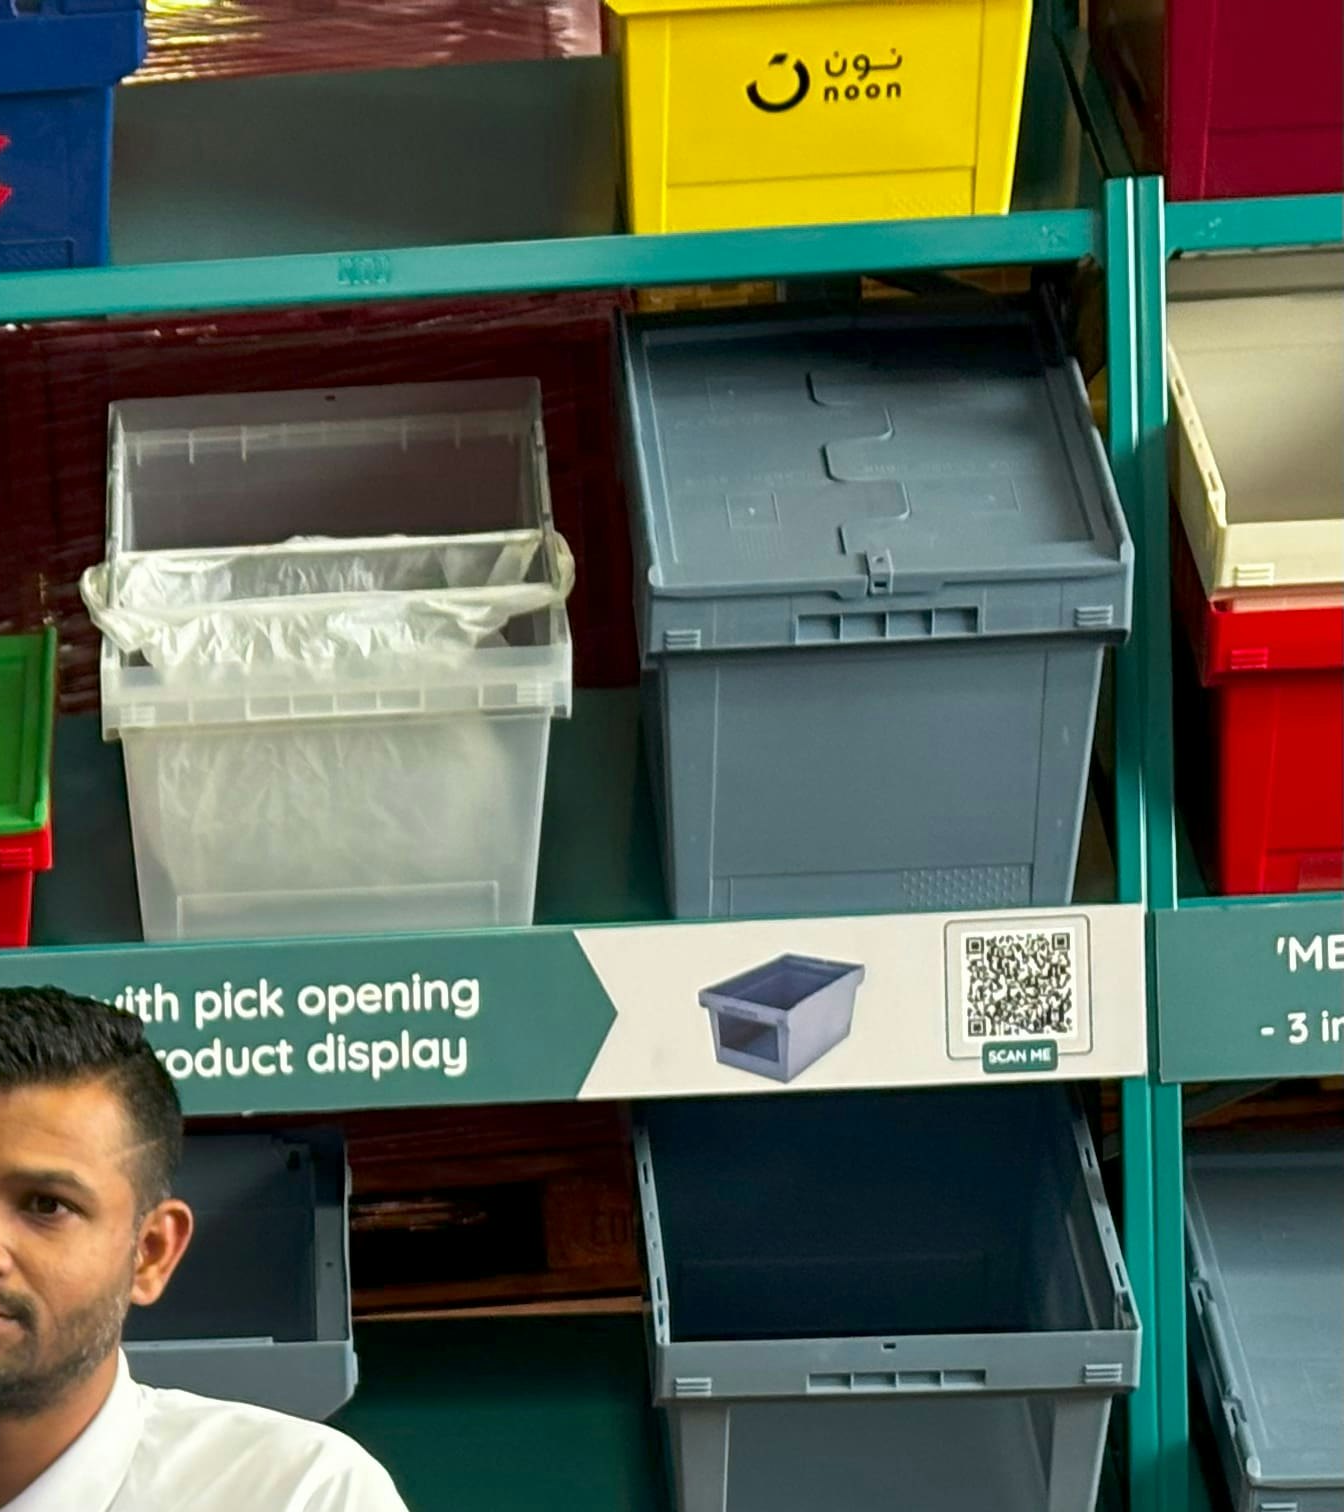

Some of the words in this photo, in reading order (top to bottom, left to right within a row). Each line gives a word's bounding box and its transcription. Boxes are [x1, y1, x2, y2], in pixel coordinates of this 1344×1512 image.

[823, 82, 902, 102] noon
[194, 978, 285, 1031] pick
[297, 972, 480, 1025] opening
[1287, 1011, 1310, 1045] 3
[307, 1028, 468, 1081] display
[988, 1048, 1027, 1065] SCAN
[1030, 1046, 1052, 1062] ME
